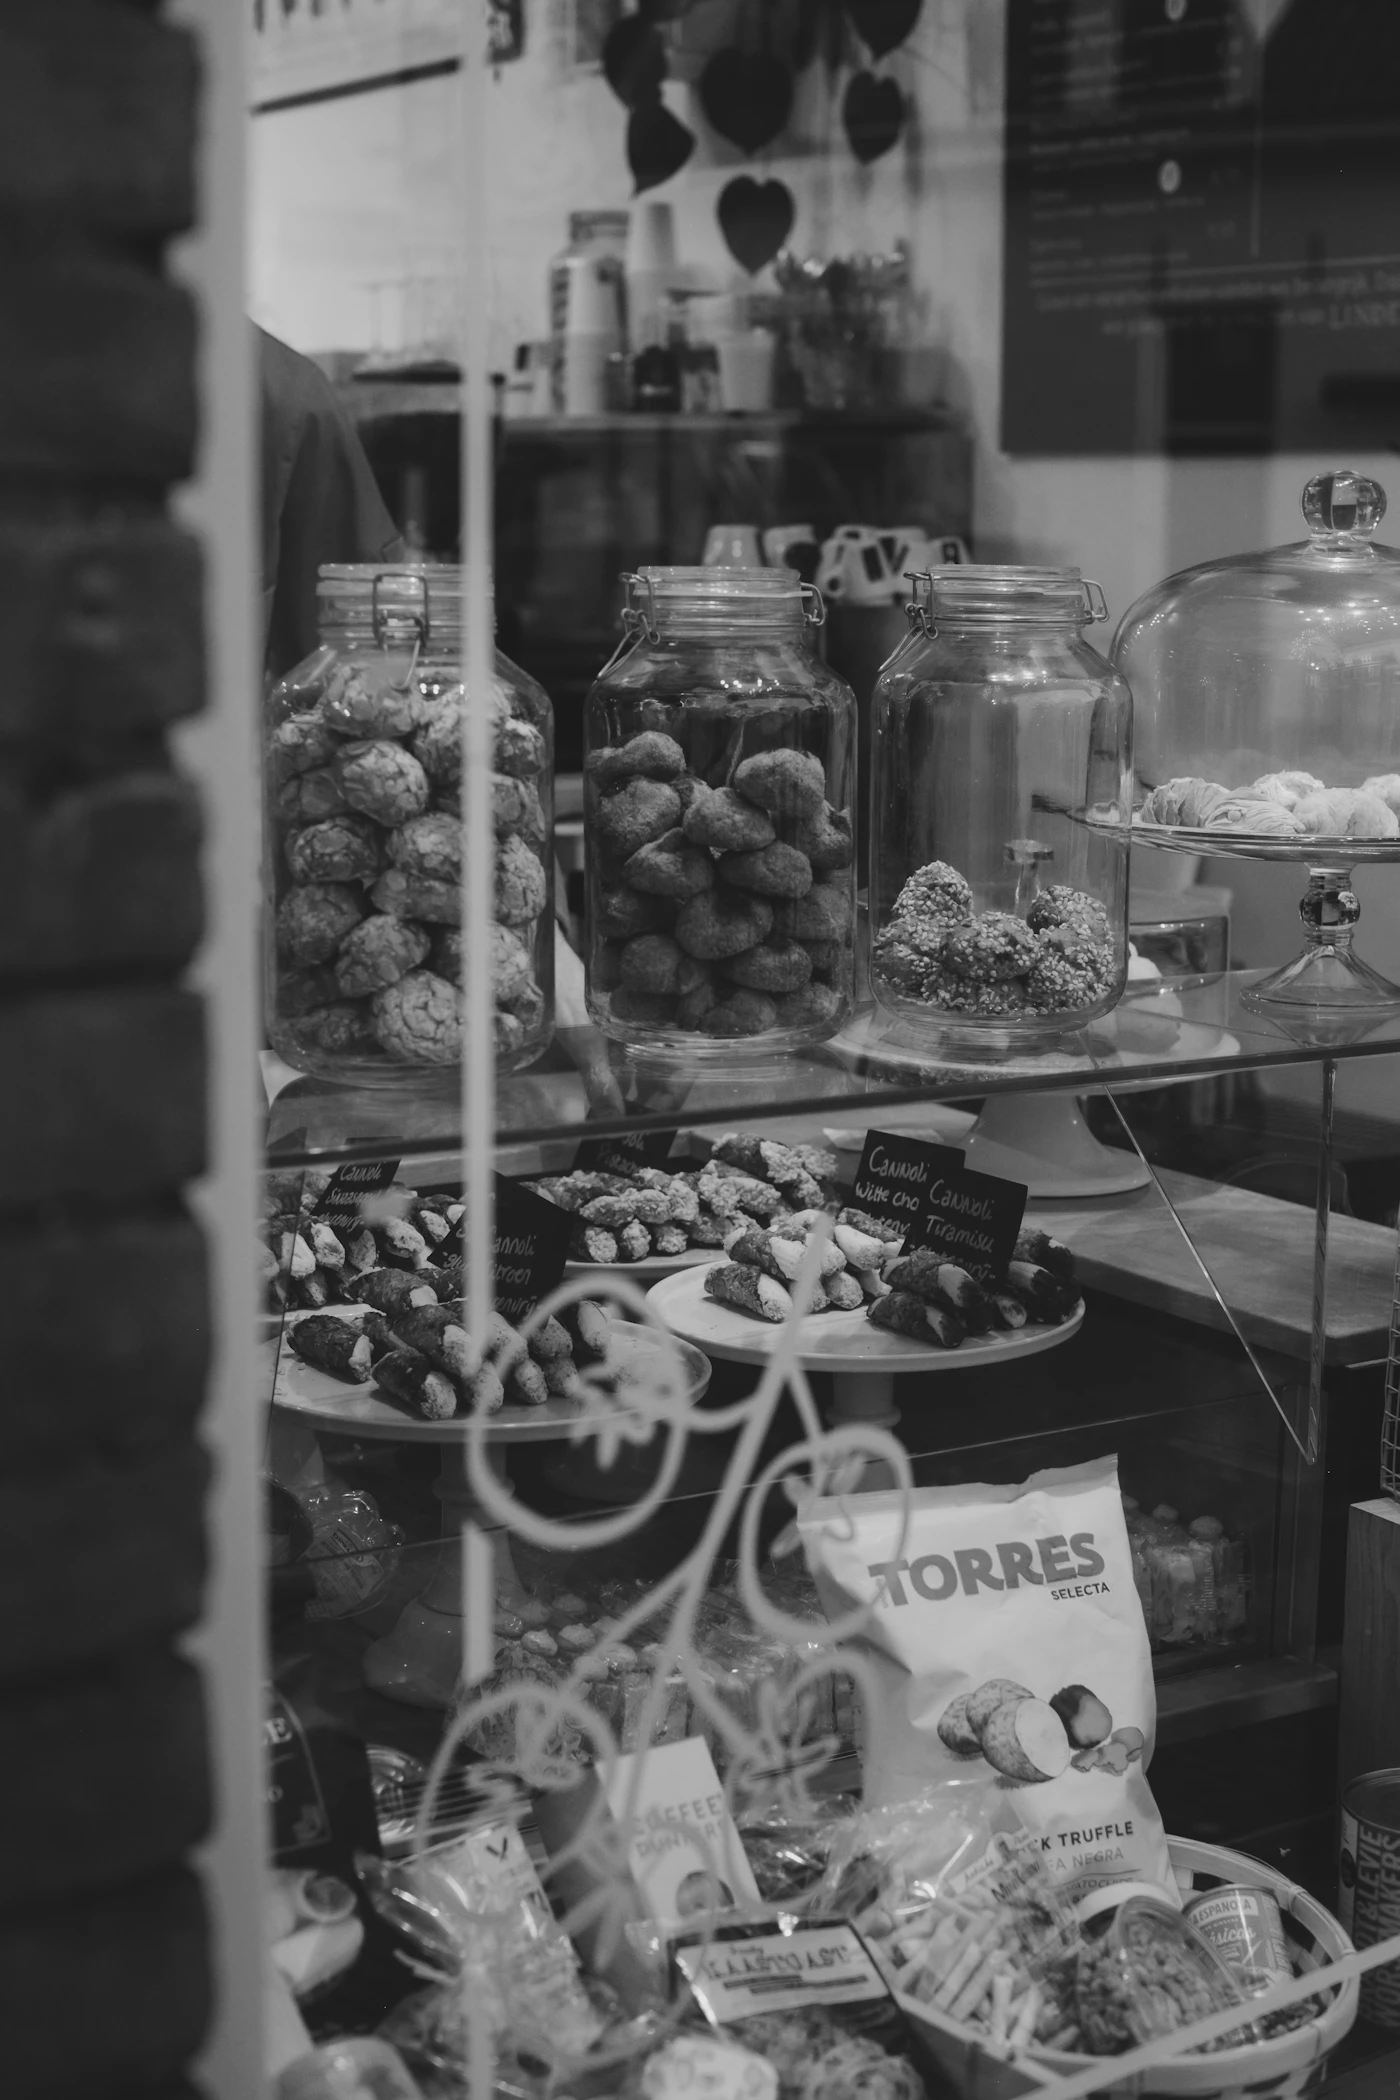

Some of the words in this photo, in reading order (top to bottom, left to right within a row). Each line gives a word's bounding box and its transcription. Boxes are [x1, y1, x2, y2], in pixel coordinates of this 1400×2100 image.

[869, 1145, 931, 1183] Cannoli
[929, 1178, 995, 1220] Cannoli
[492, 1233, 537, 1257] annoli
[926, 1214, 995, 1254] Tiramisu
[868, 1532, 1106, 1608] TORRES
[1051, 1581, 1111, 1602] SELECTA
[1058, 1820, 1134, 1847] TRUFFLE
[1073, 1846, 1125, 1868] NEGRA
